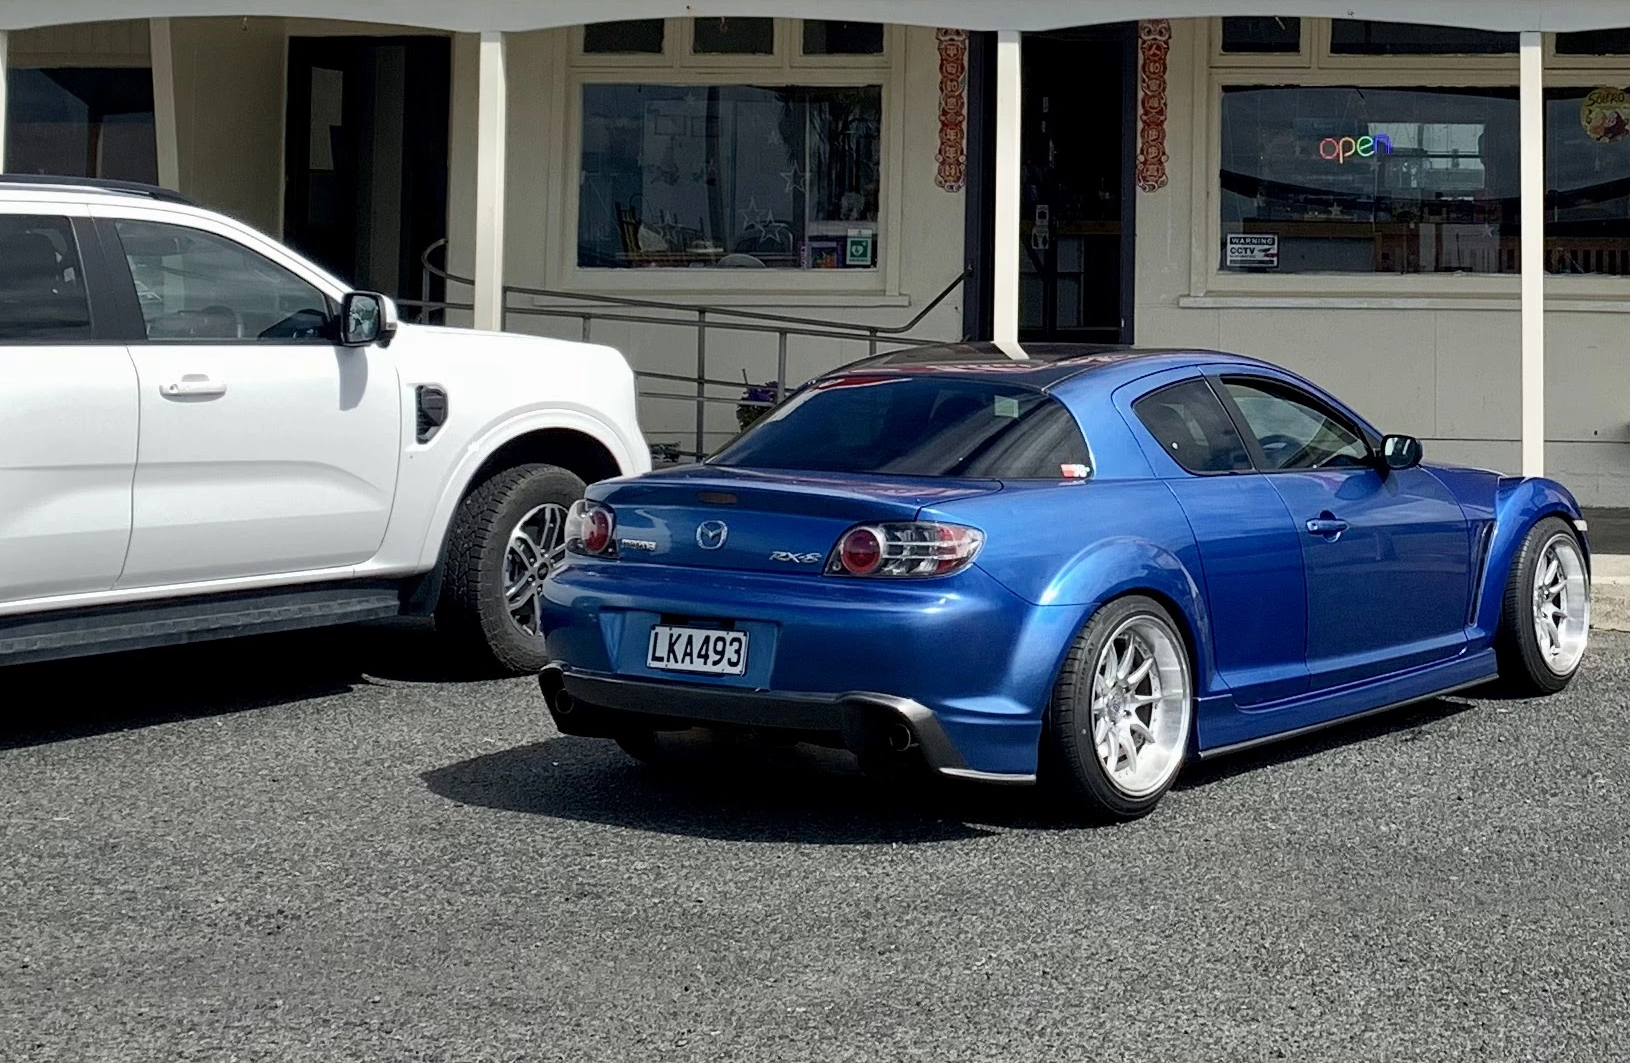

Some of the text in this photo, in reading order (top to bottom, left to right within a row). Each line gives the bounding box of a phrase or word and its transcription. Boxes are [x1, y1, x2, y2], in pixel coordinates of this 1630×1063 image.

[1319, 133, 1392, 164] open
[1229, 246, 1256, 255] CCTV
[1231, 237, 1274, 246] WARNING
[650, 631, 743, 669] LKA493
